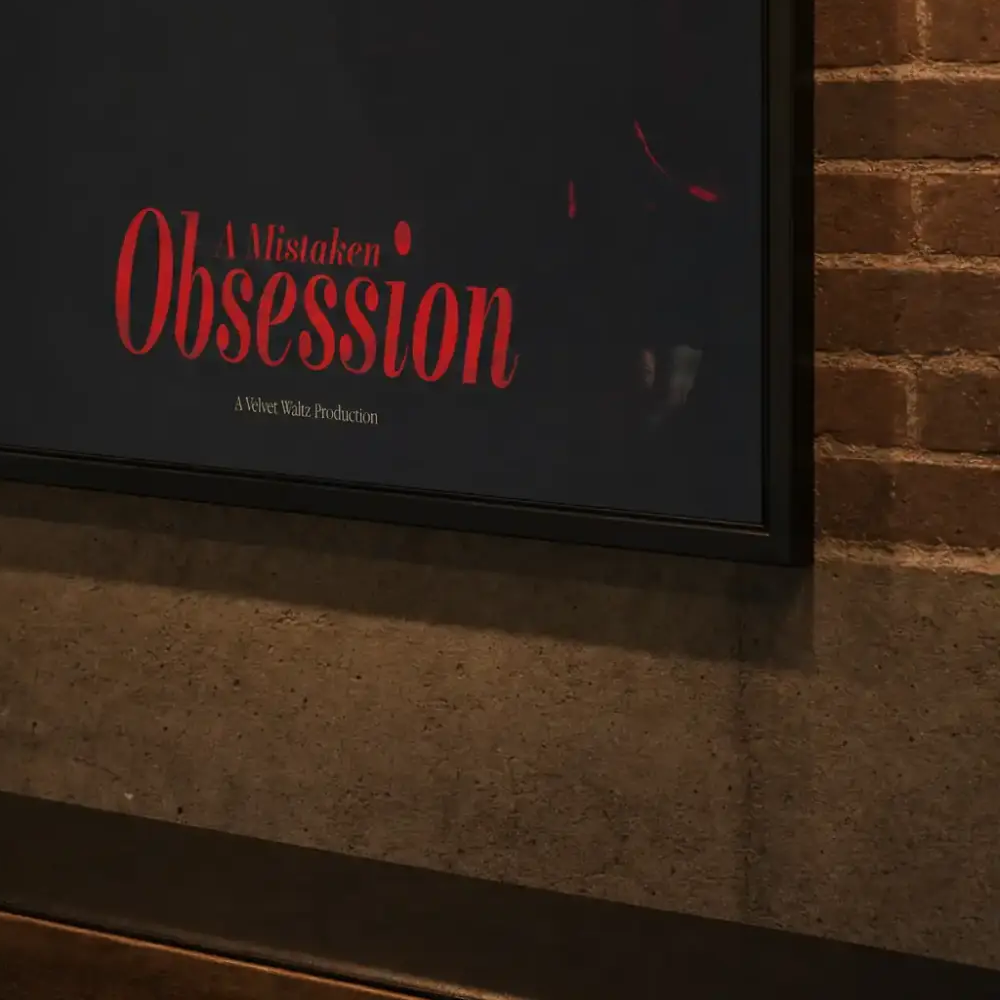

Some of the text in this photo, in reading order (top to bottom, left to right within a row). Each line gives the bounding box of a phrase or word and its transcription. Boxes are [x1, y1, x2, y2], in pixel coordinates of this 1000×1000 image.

[214, 219, 381, 268] A Mistaken
[115, 207, 520, 389] Obsession
[234, 395, 378, 425] A Velvet Waltz Production
